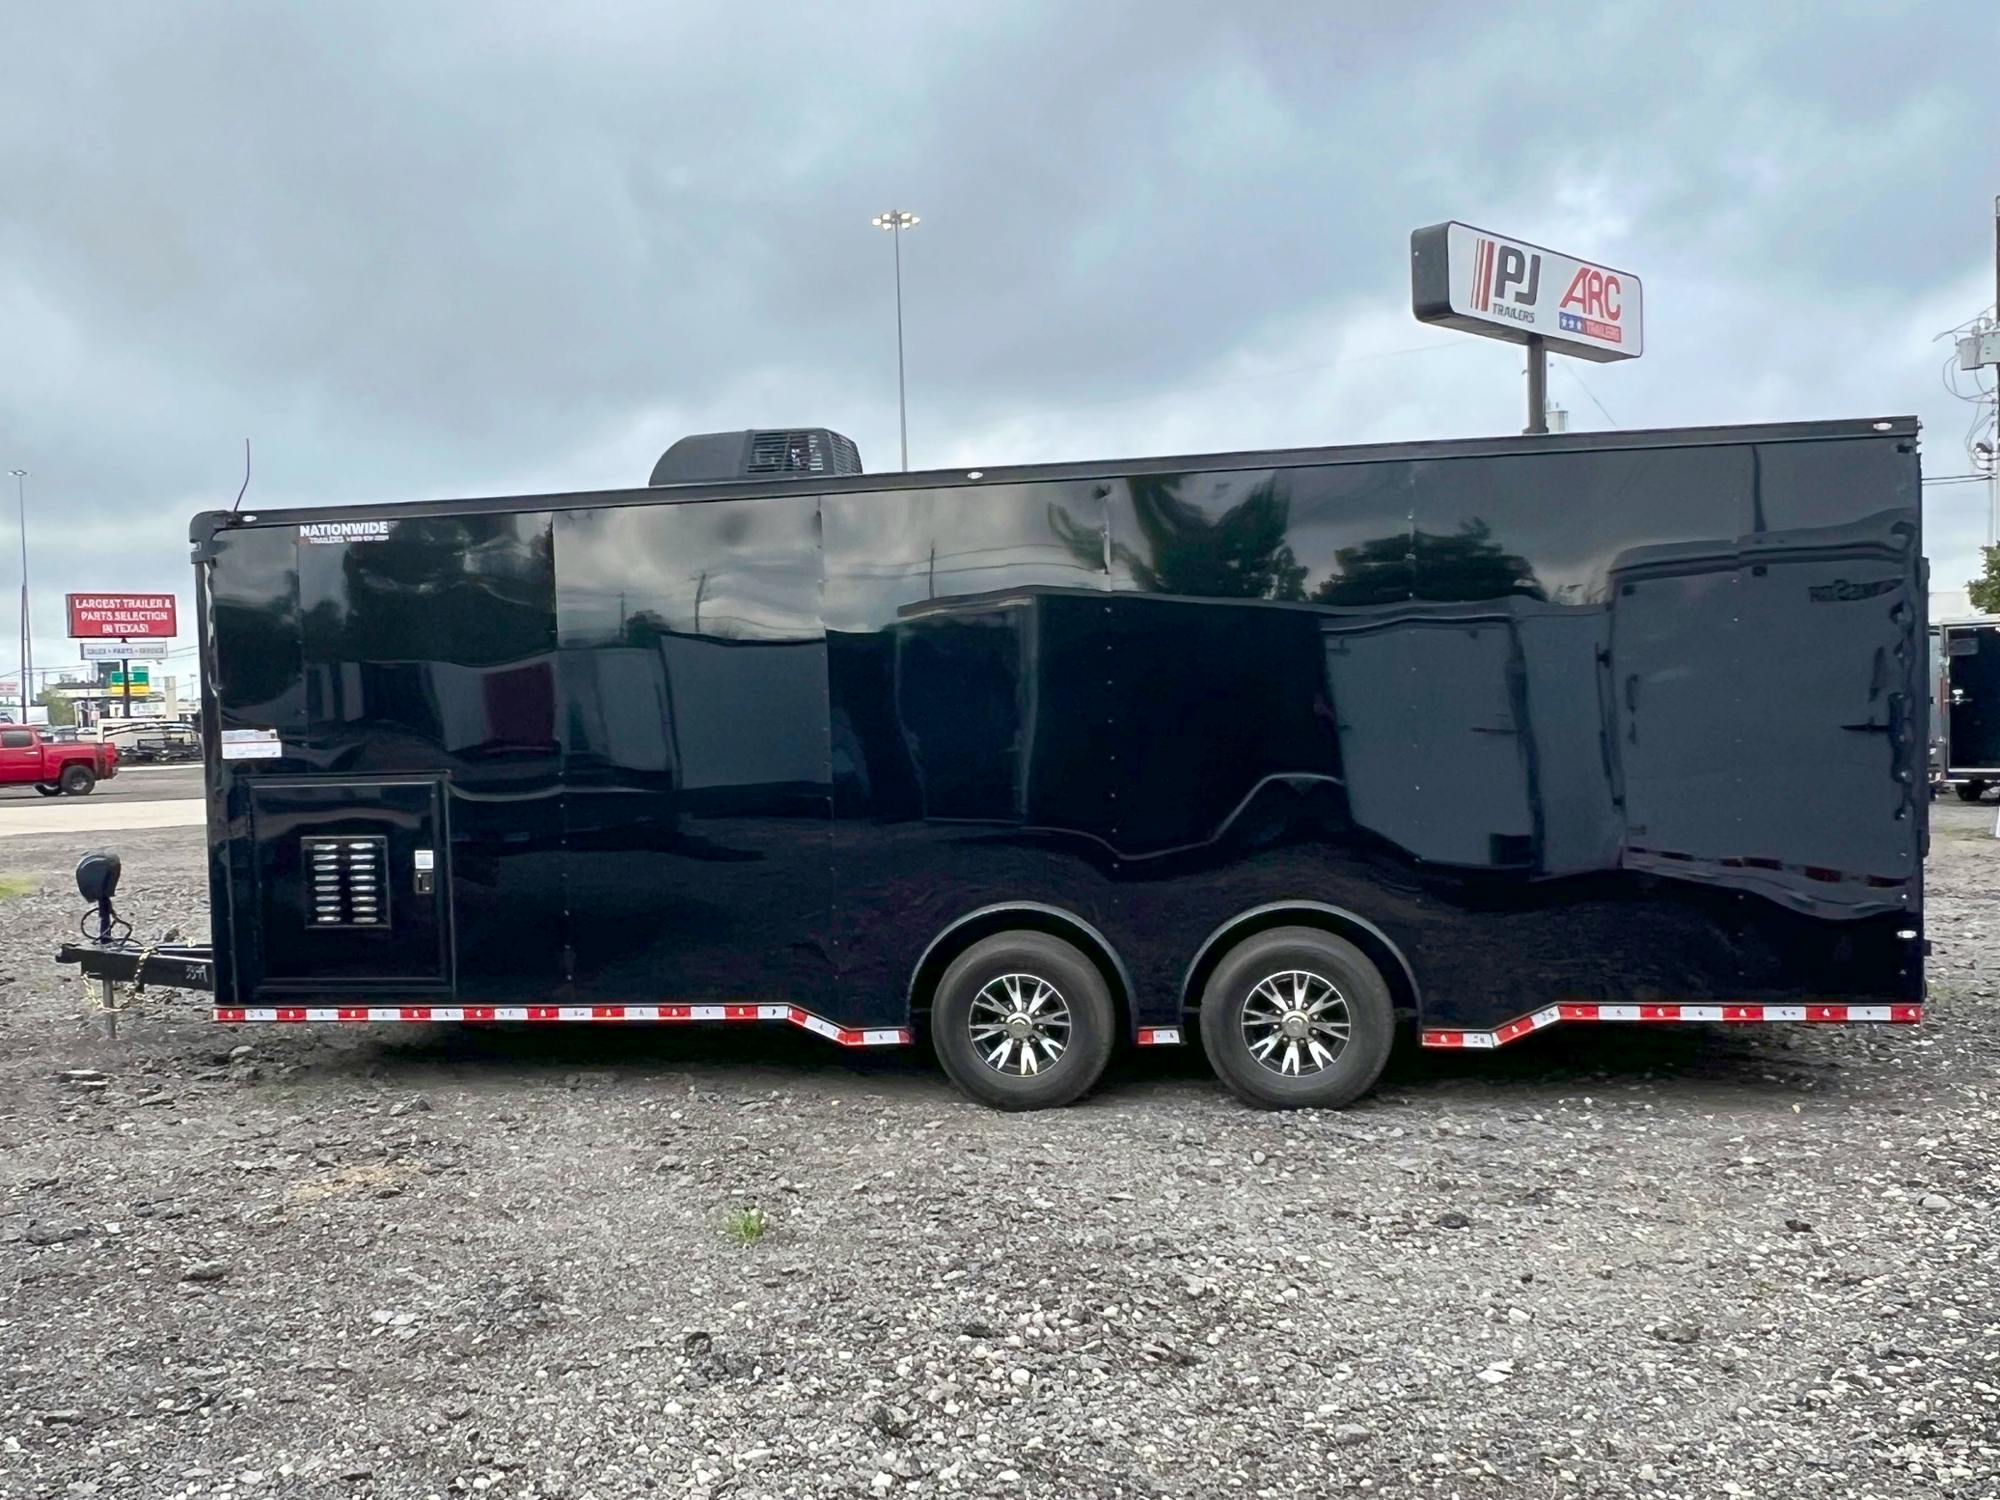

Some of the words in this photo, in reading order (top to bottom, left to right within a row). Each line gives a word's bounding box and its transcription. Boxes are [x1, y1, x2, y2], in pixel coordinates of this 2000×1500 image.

[1494, 245, 1541, 306] PJ
[1559, 267, 1621, 321] ARC
[1492, 302, 1536, 324] TRAILERS
[300, 521, 389, 537] NATIONWIDE
[75, 599, 121, 609] LARGEST
[122, 599, 163, 609] TRAILER
[164, 599, 172, 608] &
[80, 611, 113, 621] PARTS
[114, 611, 168, 621] SELECTION
[102, 623, 114, 634] IN
